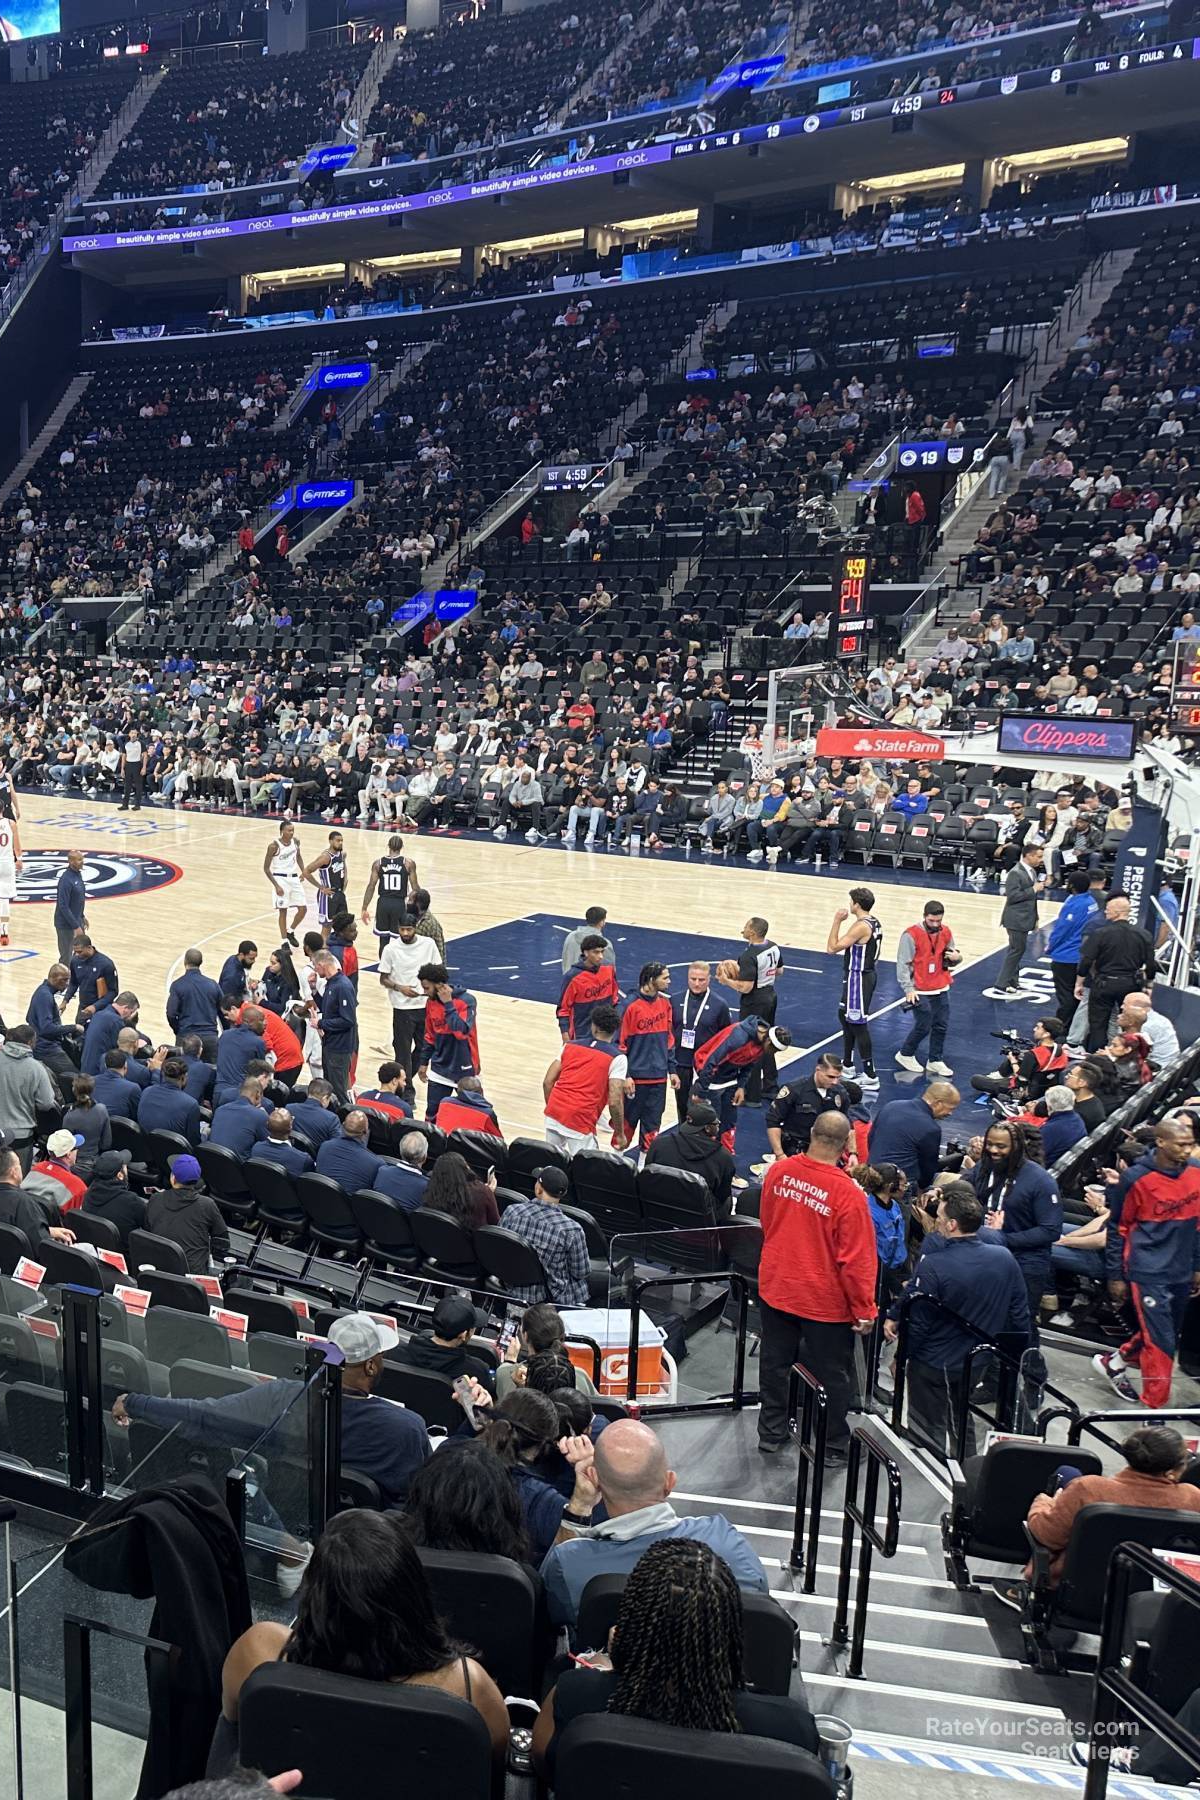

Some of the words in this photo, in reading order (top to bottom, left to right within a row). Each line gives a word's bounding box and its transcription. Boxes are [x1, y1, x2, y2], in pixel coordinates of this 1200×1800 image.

[1139, 50, 1165, 64] FOULS:
[1173, 45, 1182, 58] 4
[1050, 68, 1061, 83] 8
[940, 90, 954, 104] 24
[891, 95, 922, 115] 4:59
[850, 107, 867, 122] 1ST
[767, 124, 780, 138] 19
[700, 139, 707, 151] 4
[616, 152, 648, 167] neat.
[471, 181, 511, 195] Beautifully
[512, 176, 538, 189] simple
[539, 170, 562, 181] video
[562, 164, 597, 177] devices.
[427, 192, 454, 204] neat.
[291, 212, 330, 224] Beautifully
[332, 208, 356, 220] simple
[358, 206, 379, 216] video
[381, 201, 412, 212] devices.
[248, 219, 275, 231] neat.
[73, 238, 100, 248] neat.
[116, 234, 154, 245] Beautifully
[156, 230, 180, 242] simple
[181, 229, 201, 239] video
[202, 226, 232, 237] devices.
[921, 450, 938, 464] 19
[548, 471, 559, 480] 1ST
[565, 469, 587, 481] 4:59
[313, 489, 347, 498] FITNESS
[841, 579, 863, 615] 24
[1023, 723, 1108, 749] Clippers
[873, 739, 907, 752] State
[907, 740, 940, 754] Farm
[382, 873, 401, 891] 10
[1128, 866, 1145, 926] PECHANG
[782, 1174, 828, 1202] FANDOM
[773, 1185, 801, 1203] LIVES
[803, 1197, 832, 1217] HERE
